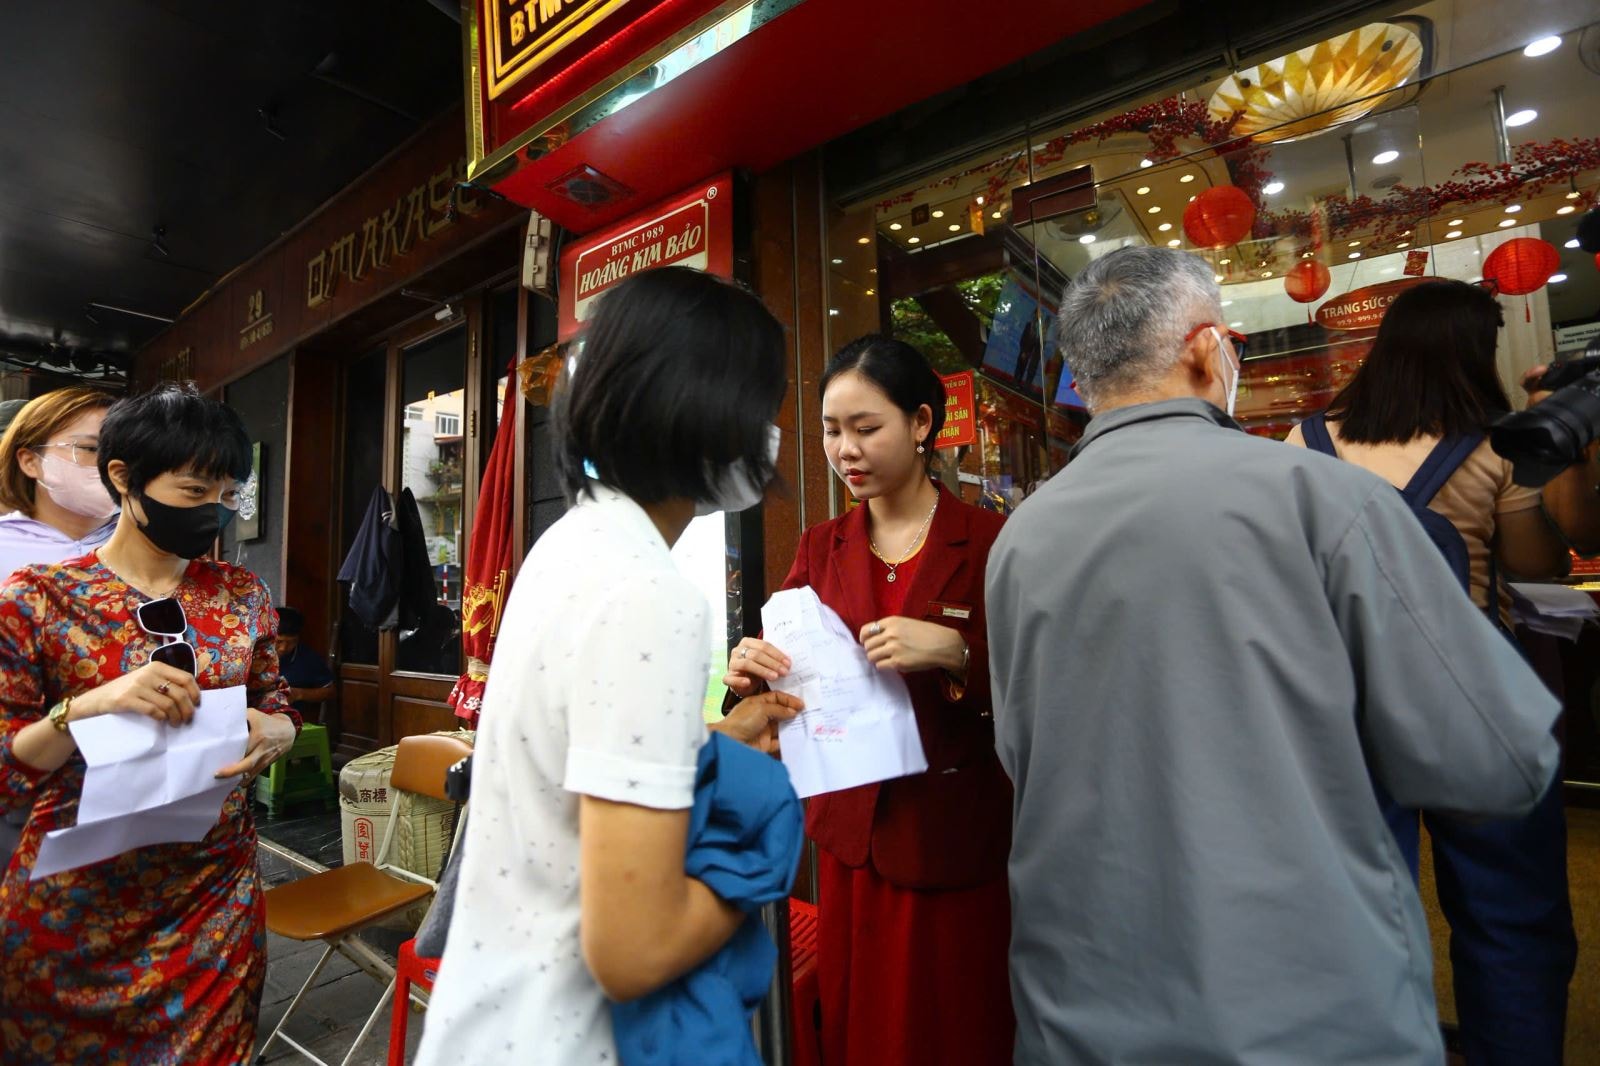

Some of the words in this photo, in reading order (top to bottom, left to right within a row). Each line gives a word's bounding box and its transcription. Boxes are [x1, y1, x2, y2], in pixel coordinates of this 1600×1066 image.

[510, 0, 575, 47] BTM
[611, 236, 639, 257] BTMC
[641, 224, 665, 244] 1989
[579, 255, 630, 295] HOÀNG
[631, 241, 662, 273] KIM
[664, 222, 702, 260] BẢO
[1322, 302, 1360, 319] TRANG
[1362, 296, 1385, 311] SỨC
[359, 788, 388, 804] 商標
